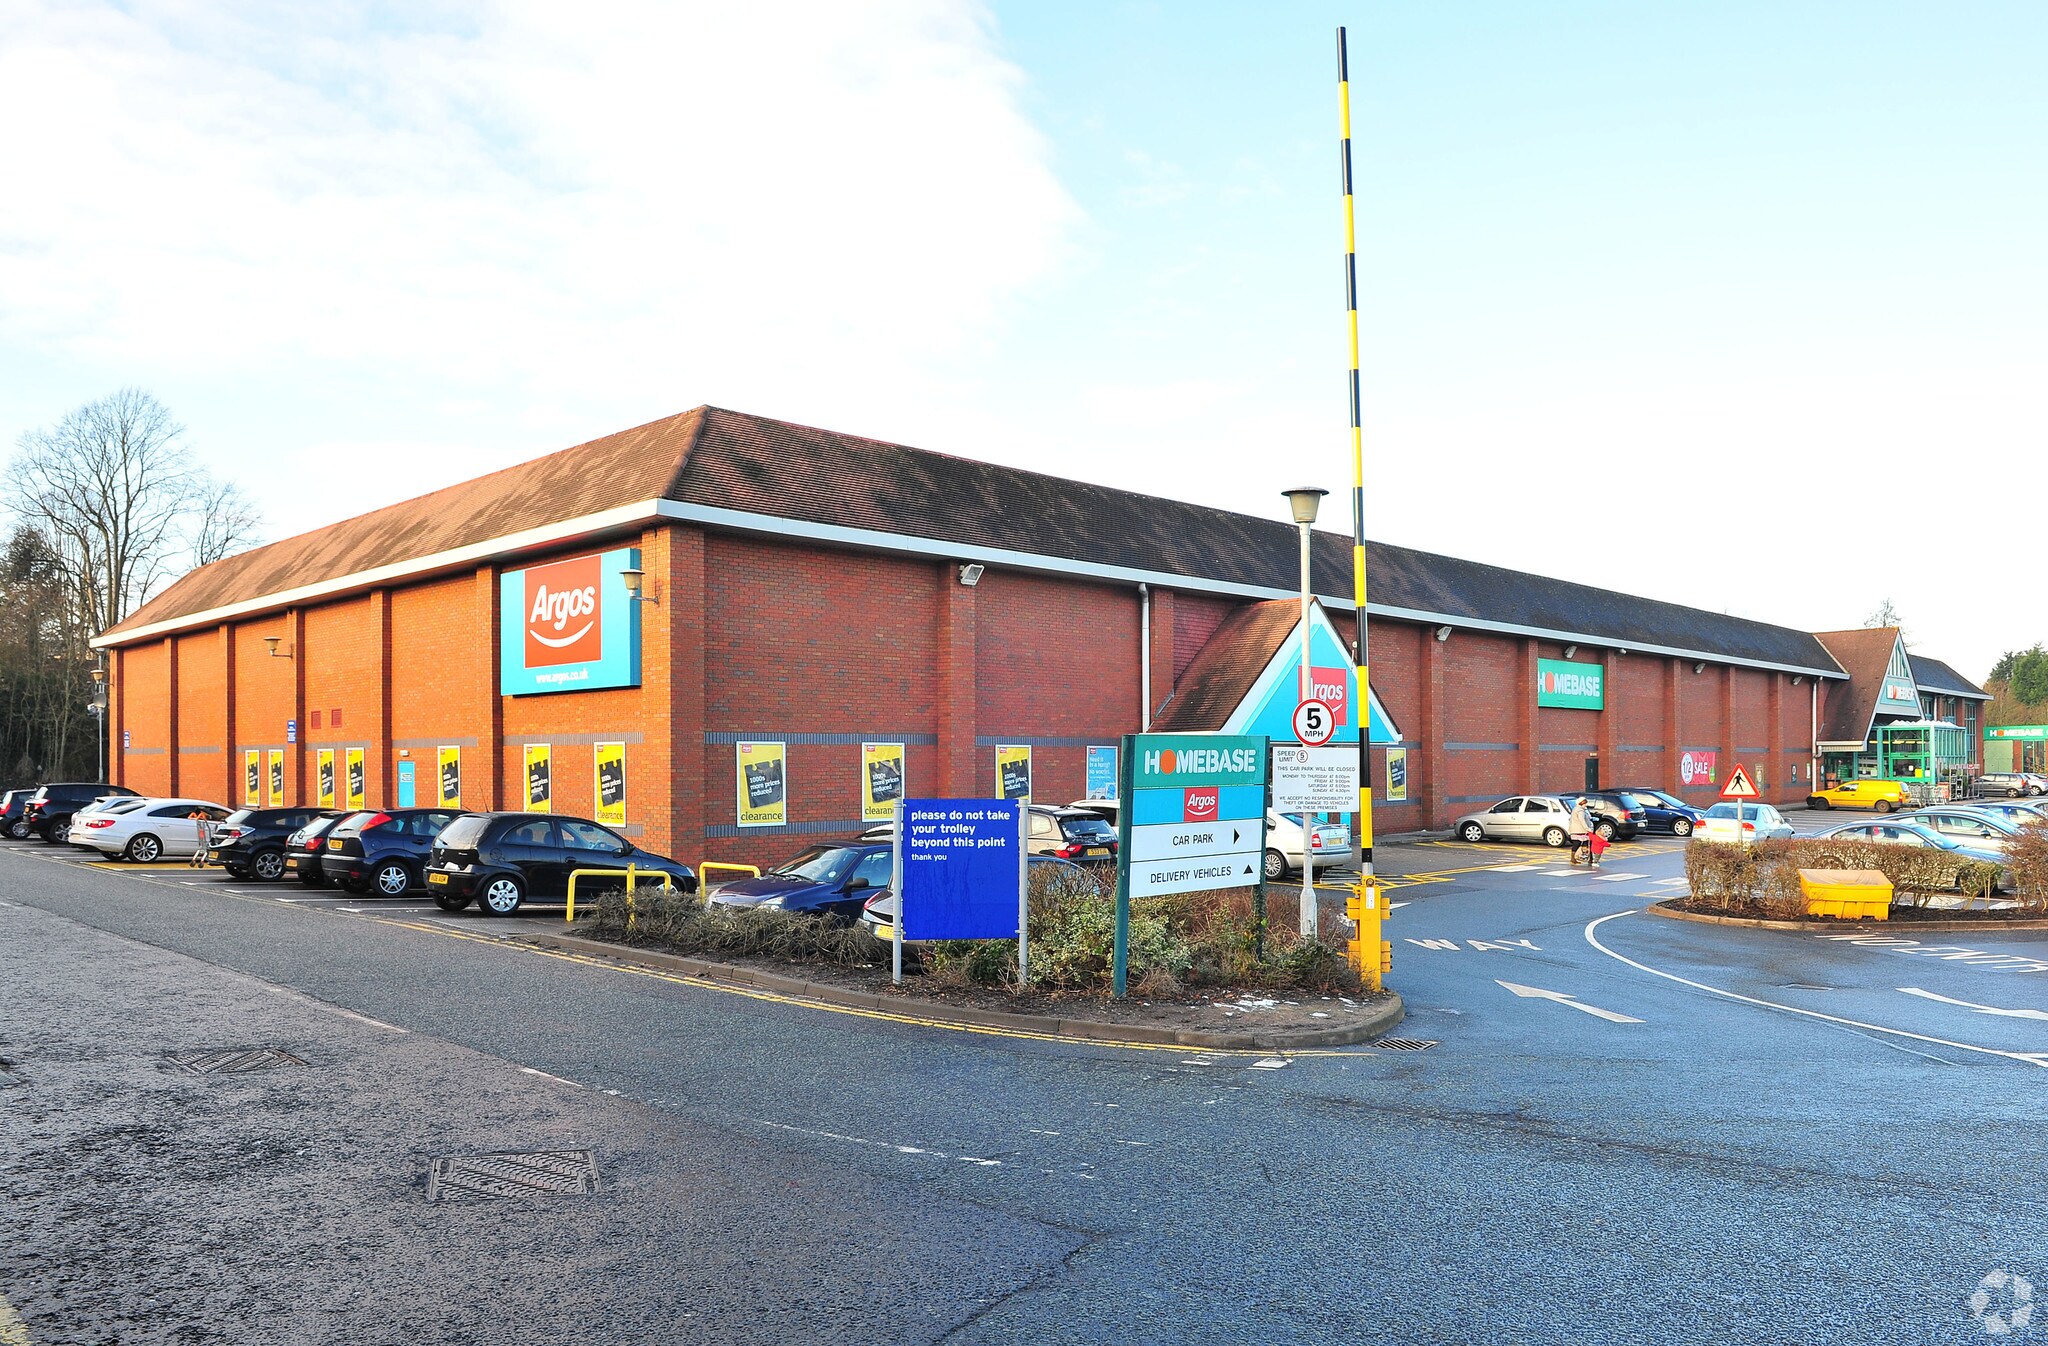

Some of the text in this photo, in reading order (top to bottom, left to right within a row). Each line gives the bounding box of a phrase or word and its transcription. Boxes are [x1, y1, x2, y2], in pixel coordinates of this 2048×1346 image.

[530, 584, 595, 631] Argos
[535, 668, 589, 684] www.argos.co.uk
[1538, 671, 1600, 697] HOMEBASE
[1306, 707, 1322, 730] 5
[1144, 748, 1256, 775] HOMEBASE
[1683, 760, 1708, 774] 1/2 SALE
[750, 776, 766, 784] 1000s
[764, 780, 780, 788] prices
[751, 787, 772, 797] reduced
[1187, 793, 1216, 810] Argos
[741, 812, 782, 820] clearance
[865, 806, 894, 815] clearan
[911, 810, 1010, 822] please do not take
[912, 824, 976, 835] your trolley
[911, 837, 1005, 849] beyond this point
[1172, 833, 1214, 846] CAR PARK
[1150, 866, 1232, 884] DELIVERY VEHICLES
[1404, 938, 1543, 951] WAY
